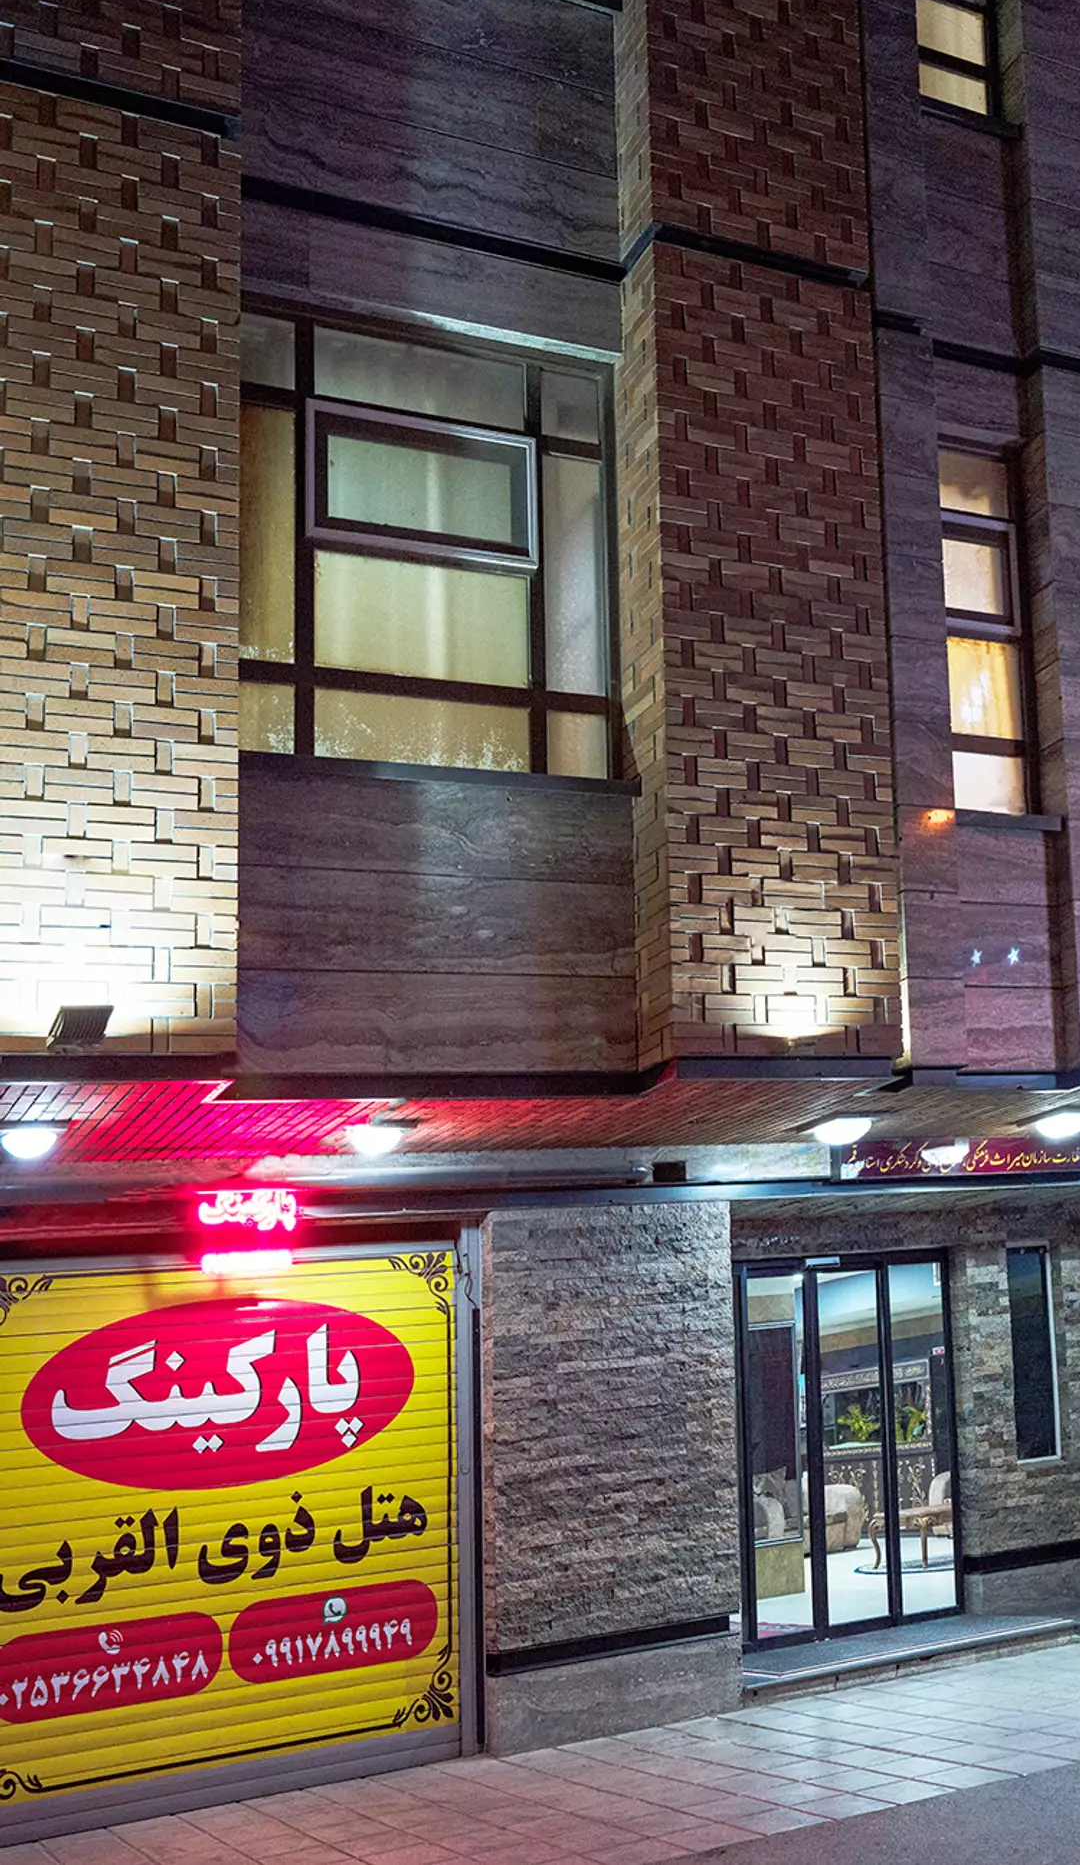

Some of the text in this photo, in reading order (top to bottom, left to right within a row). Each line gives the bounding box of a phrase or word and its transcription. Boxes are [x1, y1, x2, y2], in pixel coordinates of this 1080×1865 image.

[51, 1324, 365, 1453] پارکینگ
[333, 1486, 428, 1564] هتل
[252, 1618, 412, 1667] ۰۹۹۱۷۸۹۹۹۴۹
